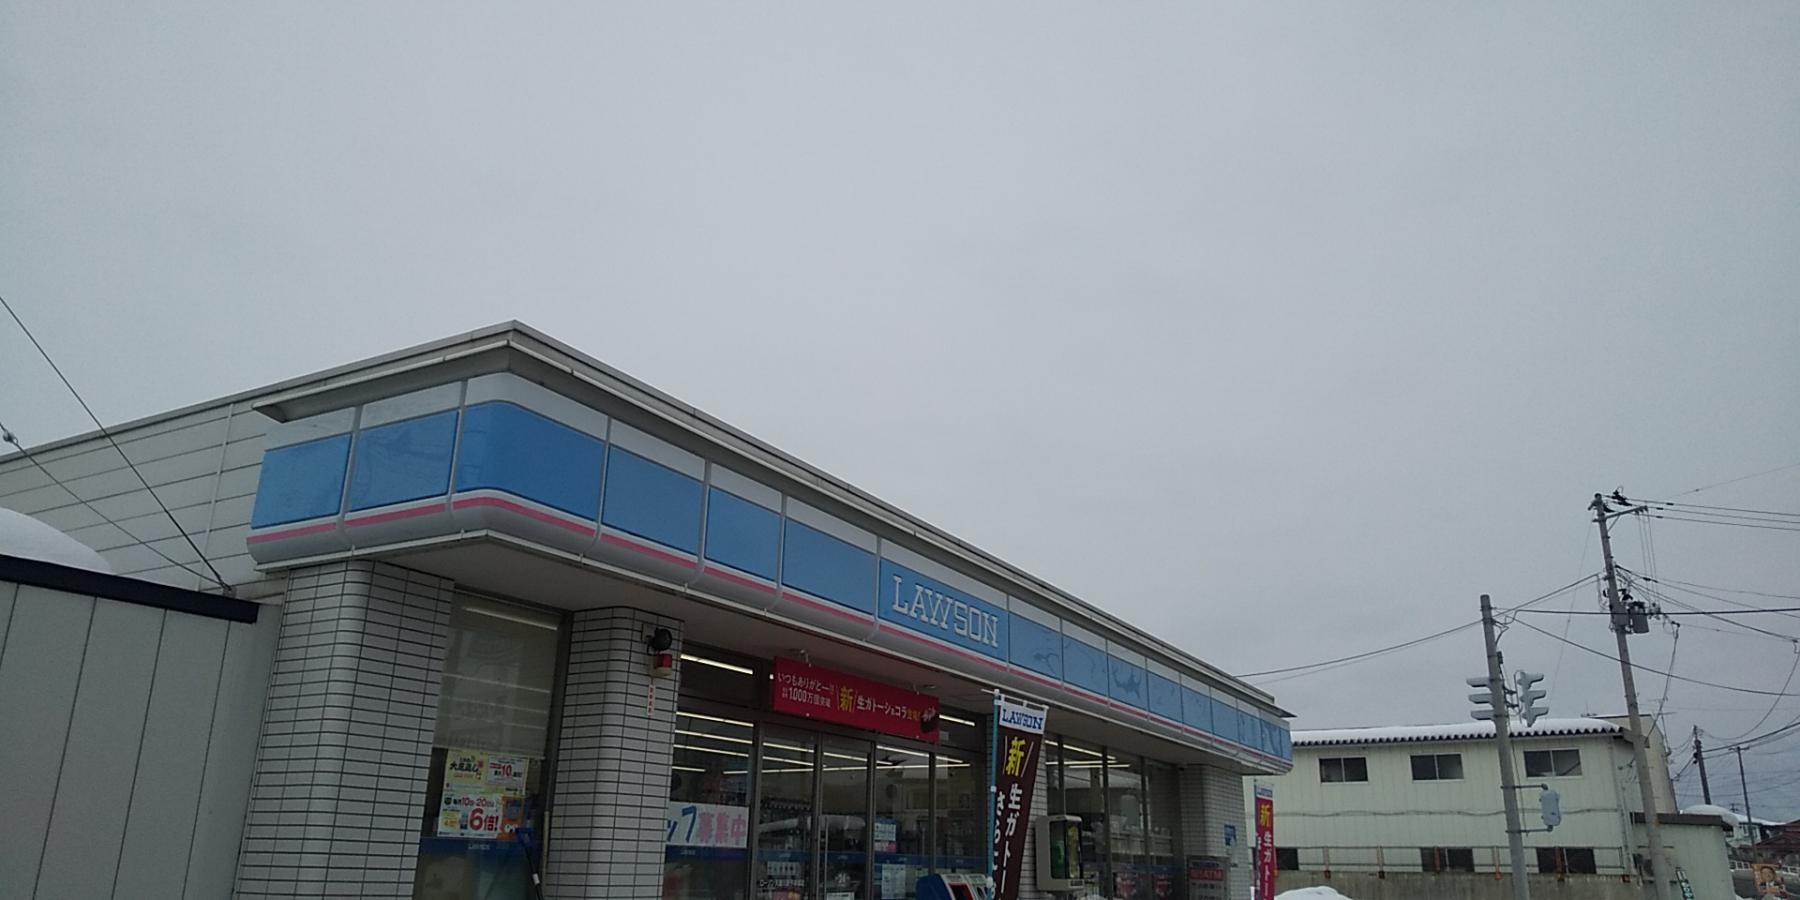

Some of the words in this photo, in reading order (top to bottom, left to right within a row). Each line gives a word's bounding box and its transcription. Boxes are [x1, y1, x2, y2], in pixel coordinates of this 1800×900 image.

[892, 575, 999, 648] LAWSON
[839, 687, 854, 712] 新
[1002, 708, 1044, 731] LAWSON
[1006, 736, 1026, 777] 新
